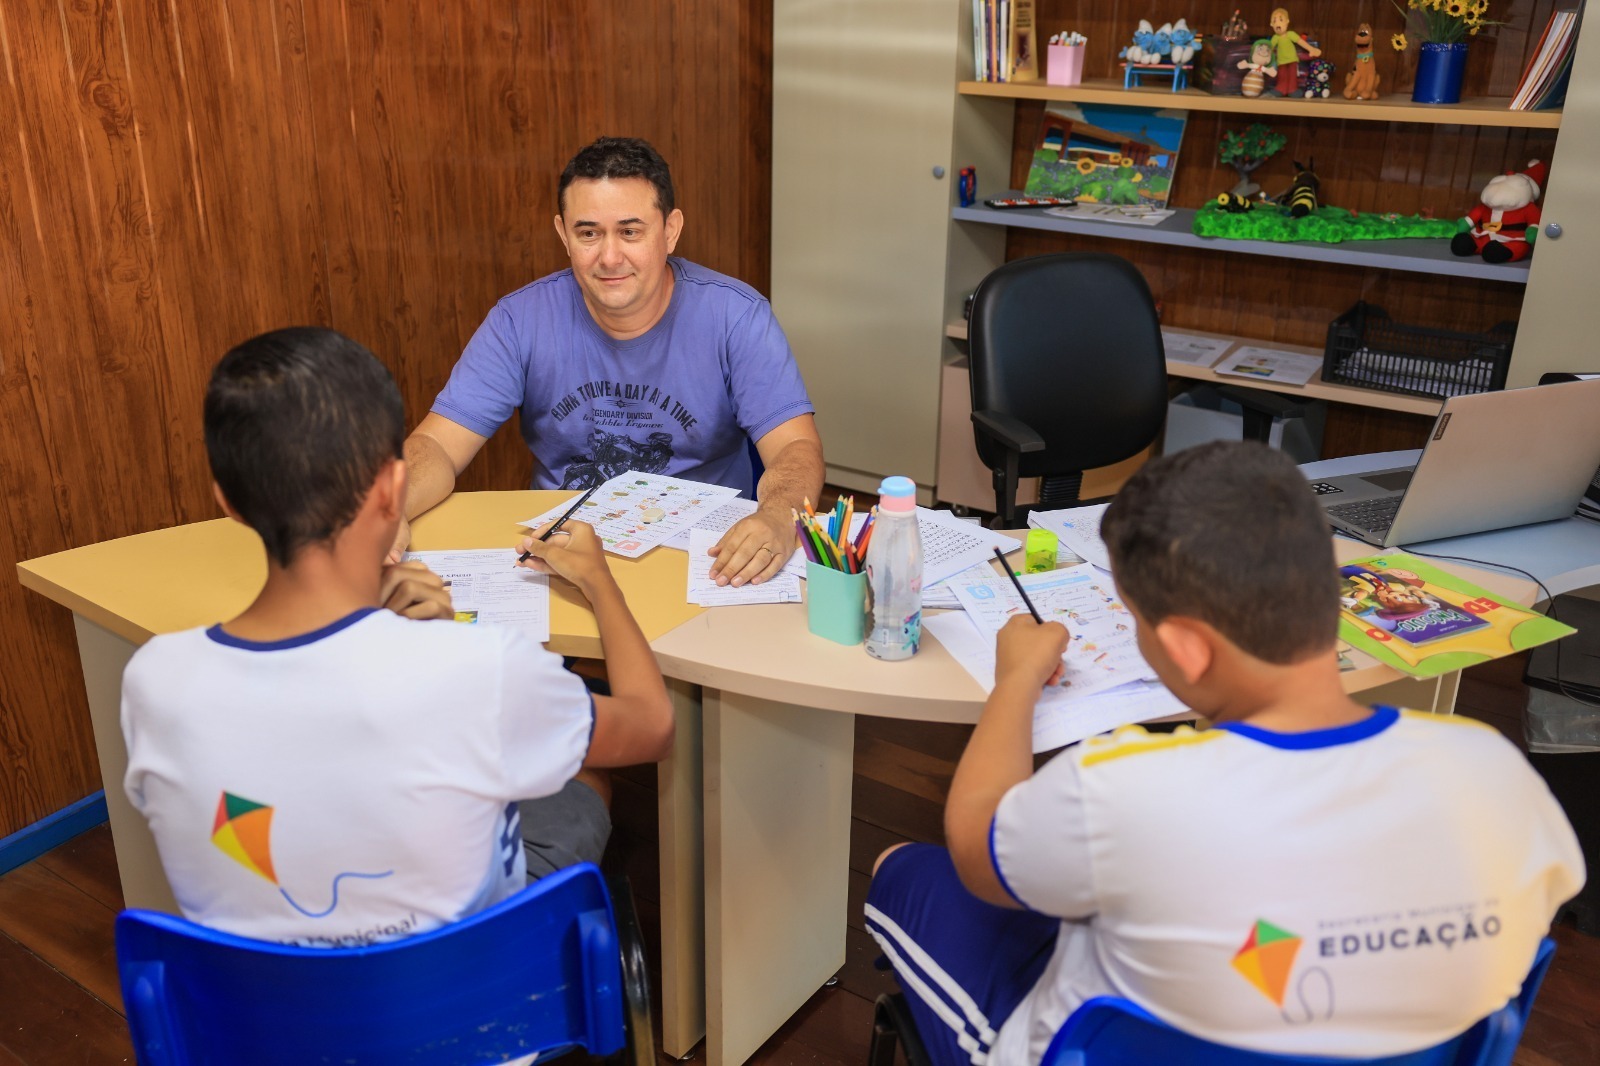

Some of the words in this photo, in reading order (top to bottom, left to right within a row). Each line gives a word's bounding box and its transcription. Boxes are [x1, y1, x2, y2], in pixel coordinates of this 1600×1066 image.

[592, 408, 624, 419] GENDARY
[615, 382, 622, 397] A
[625, 383, 649, 401] DAY
[660, 395, 671, 411] A
[670, 401, 698, 431] TIME
[1319, 912, 1501, 957] EDUCAÇÃO
